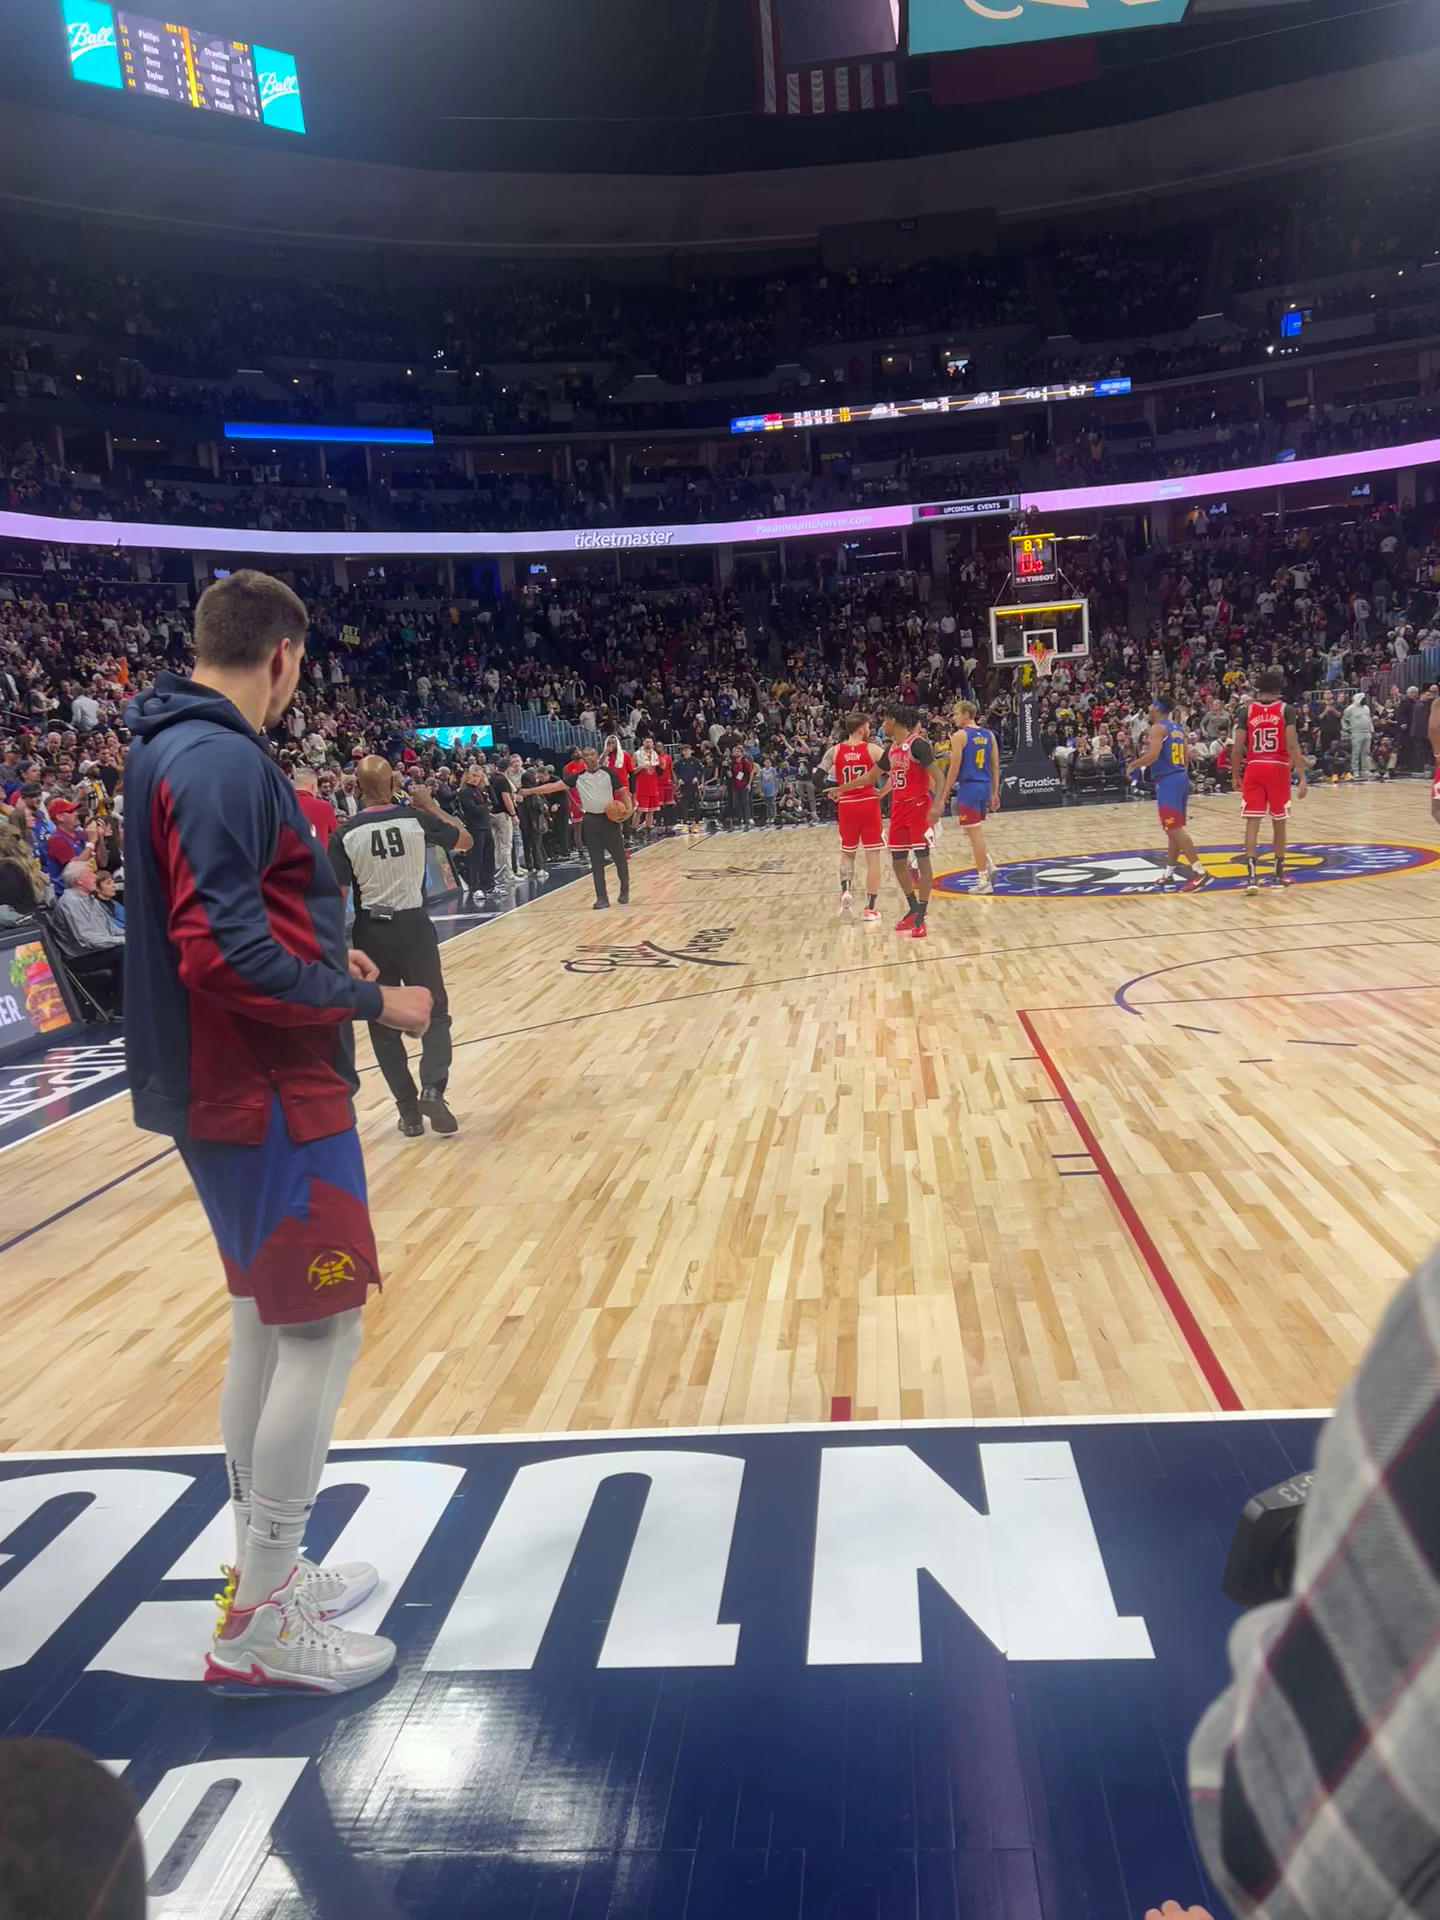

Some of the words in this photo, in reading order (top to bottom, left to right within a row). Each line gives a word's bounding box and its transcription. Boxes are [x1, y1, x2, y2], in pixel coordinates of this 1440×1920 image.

[67, 22, 114, 49] Ball
[258, 72, 298, 97] Ball
[1069, 385, 1087, 397] 8.7
[974, 396, 989, 405] TOT
[943, 504, 975, 514] UPCOMING
[977, 502, 1001, 511] EVENTS
[755, 515, 873, 534] ParamountDenver.com
[573, 531, 674, 548] ticketmaster
[1028, 573, 1056, 582] TISSOT
[1024, 703, 1034, 743] Southwest
[1250, 713, 1281, 728] PHILLIPS
[1252, 727, 1279, 753] 15
[975, 748, 985, 769] 4
[842, 764, 868, 785] 17
[1019, 776, 1061, 788] Fanatics
[1020, 786, 1055, 795] Sportsbook
[371, 826, 406, 860] 49
